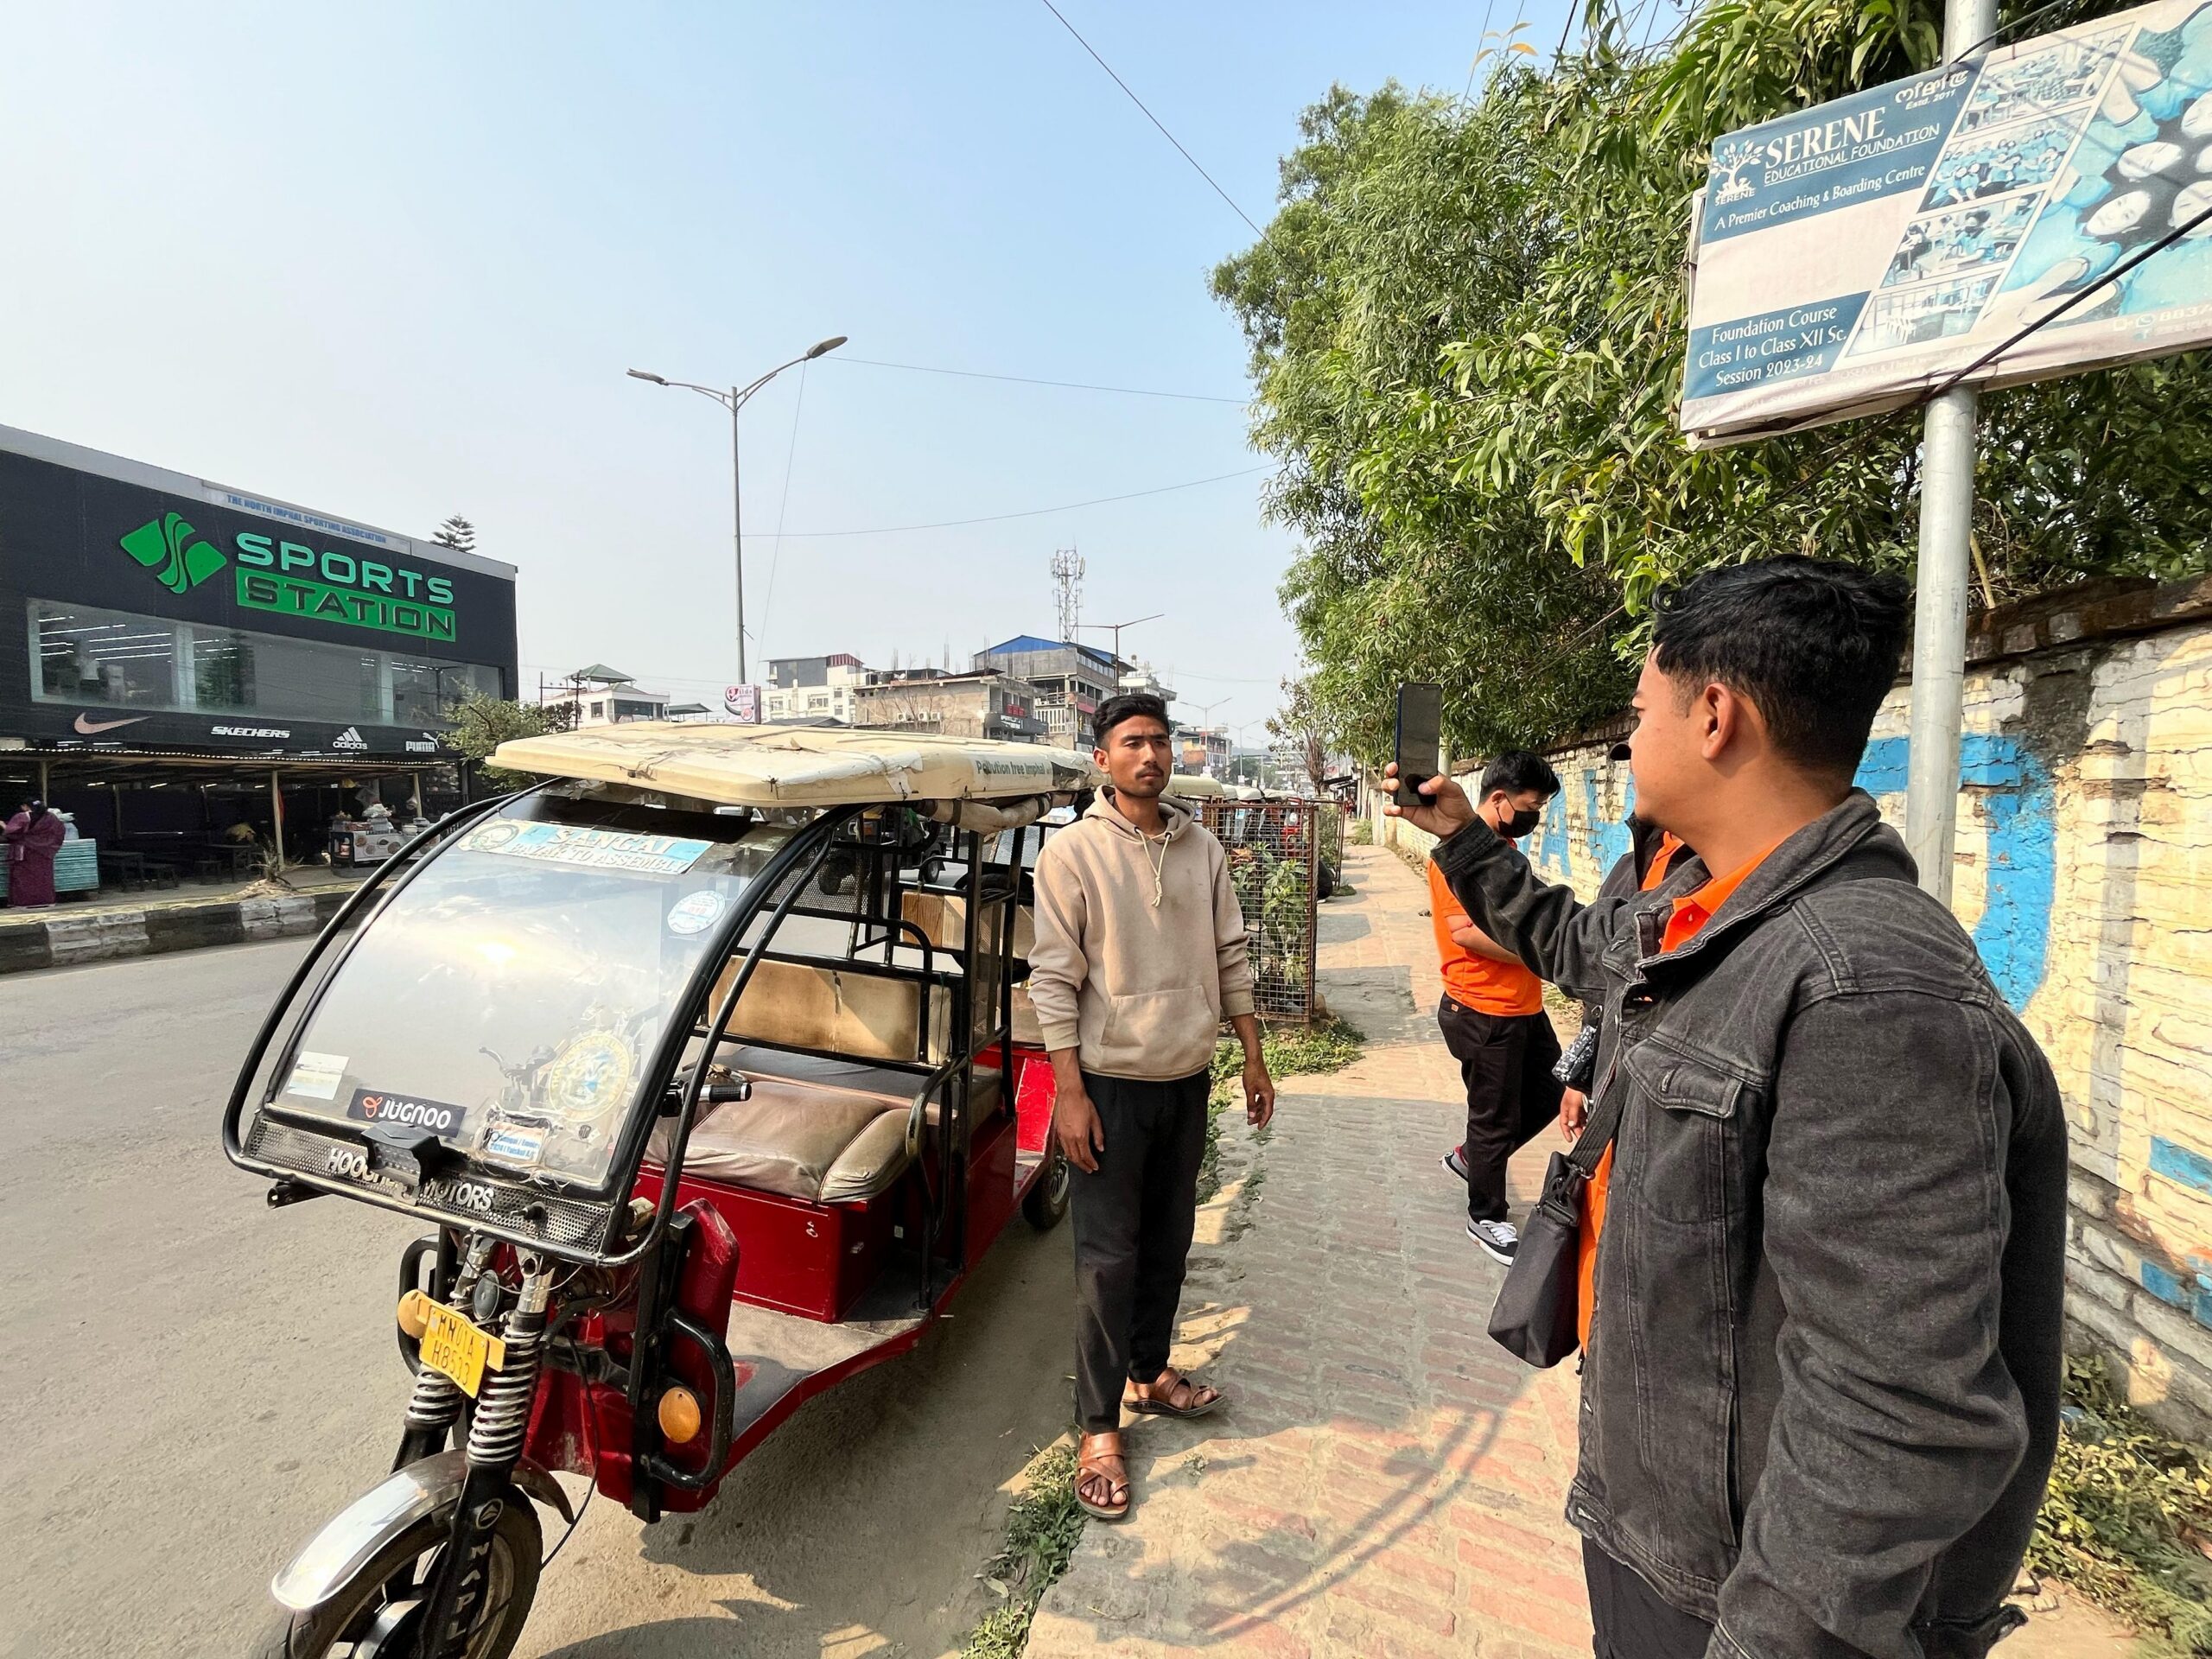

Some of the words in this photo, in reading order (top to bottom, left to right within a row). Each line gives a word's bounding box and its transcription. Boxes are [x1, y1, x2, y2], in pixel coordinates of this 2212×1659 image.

[1933, 88, 1956, 102] 2011
[1765, 106, 1886, 169] SERENE
[1764, 150, 1847, 185] EDUCATIONAL
[1851, 124, 1941, 158] FOUNDATION
[1714, 188, 1756, 207] SERENE
[1714, 216, 1726, 231] A
[1728, 207, 1767, 229] Premier
[1769, 192, 1821, 216] Coaching
[1822, 190, 1829, 203] &
[1833, 175, 1882, 200] Boarding
[1885, 164, 1925, 185] Centre
[1712, 317, 1783, 346] Foundation
[1789, 305, 1838, 329] Course
[1699, 348, 1732, 369] Class
[1735, 348, 1741, 362] I
[1745, 345, 1757, 359] to
[1761, 336, 1796, 358] Class
[1799, 328, 1823, 350] XII
[1827, 326, 1847, 343] Sc.
[1714, 364, 1761, 387] Session
[1765, 353, 1824, 379] 2023-24
[226, 493, 243, 506] THE
[244, 499, 272, 514] NORTH
[273, 505, 302, 522] IMPHAL
[303, 513, 340, 531] SPORTING
[341, 524, 386, 543] ASSOCIATION
[236, 531, 454, 604] SPORTS
[245, 575, 452, 638] STATION
[211, 726, 290, 739] SKECHERS
[332, 739, 368, 750] adidas
[405, 741, 435, 753] PUMA
[1011, 761, 1025, 775] free
[1025, 762, 1046, 776] Imphal
[547, 828, 677, 855] SANGAI
[568, 848, 593, 862] TO
[594, 851, 689, 873] ASSEMBLY
[423, 1178, 494, 1211] MOTORS
